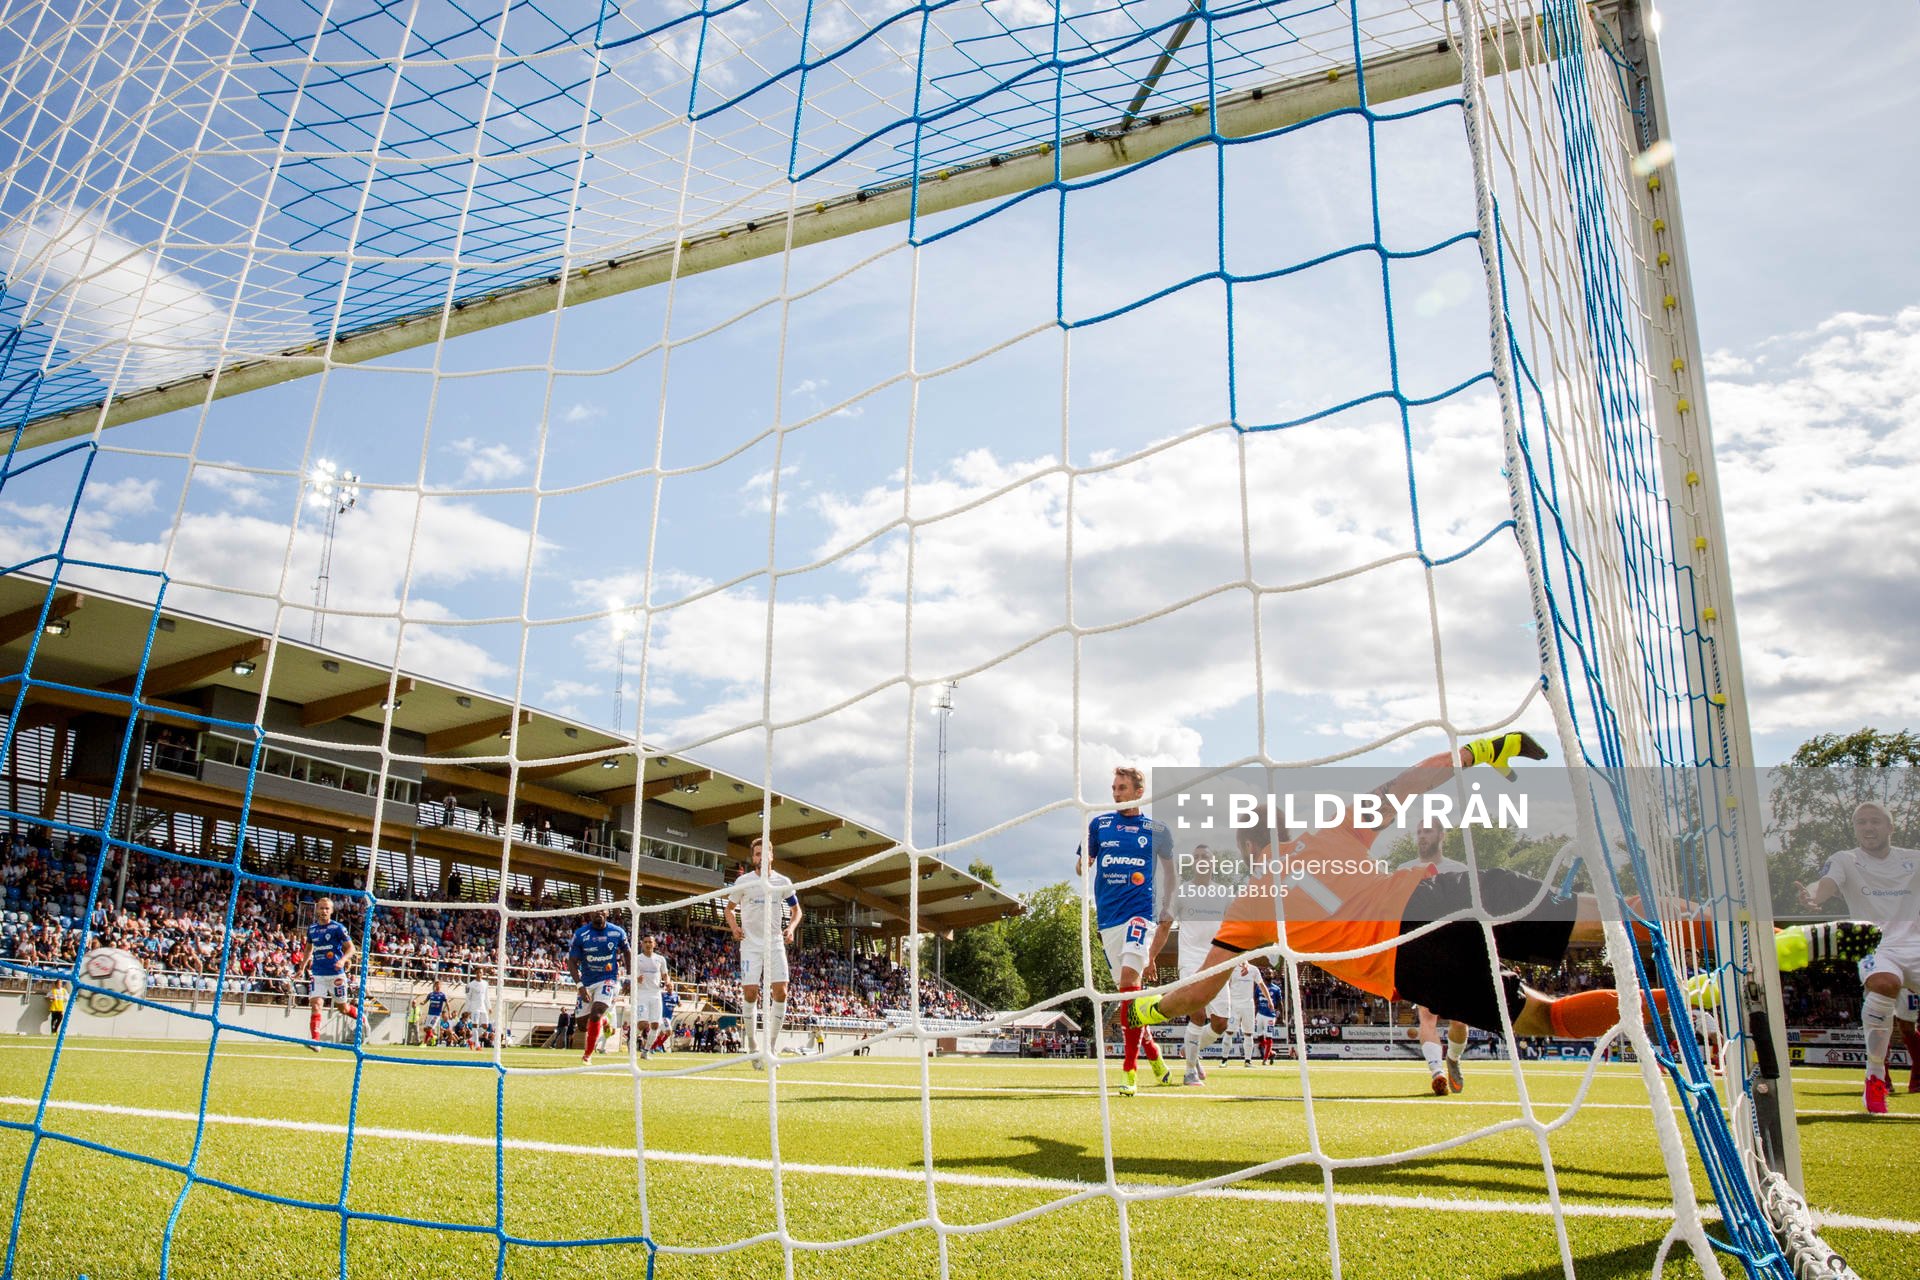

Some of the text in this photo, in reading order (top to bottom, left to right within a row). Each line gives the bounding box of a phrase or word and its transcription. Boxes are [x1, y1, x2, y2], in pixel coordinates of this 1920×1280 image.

[1101, 854, 1146, 867] CONRAD
[1290, 1027, 1329, 1036] usport
[1843, 1052, 1903, 1062] BYA
